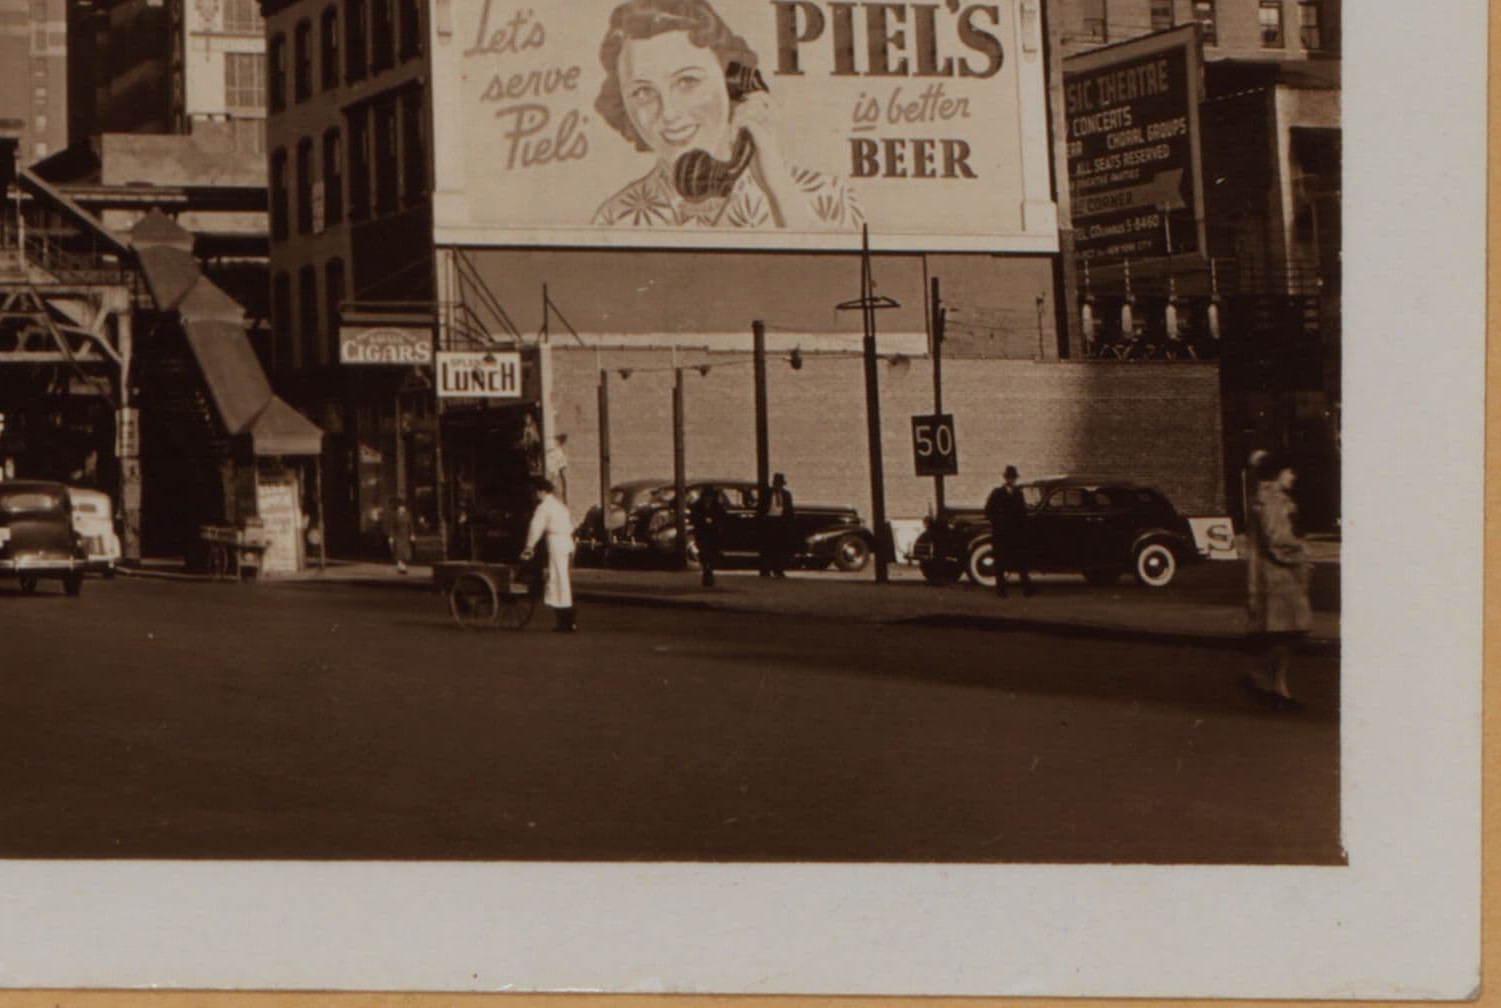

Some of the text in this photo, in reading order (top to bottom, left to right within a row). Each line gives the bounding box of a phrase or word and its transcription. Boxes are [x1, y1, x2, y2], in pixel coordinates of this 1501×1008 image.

[479, 65, 581, 102] serve
[1097, 58, 1170, 106] THEATRE
[852, 82, 972, 124] is better
[495, 103, 589, 171] Piel's
[1073, 105, 1133, 137] CONCERTS
[1146, 116, 1187, 142] GROUPS
[847, 136, 979, 179] BEER
[1094, 153, 1122, 173] SEATS
[1122, 143, 1171, 167] RESERVED
[341, 339, 430, 363] CIGARS
[441, 360, 517, 392] LUNCH
[914, 423, 953, 457] 50
